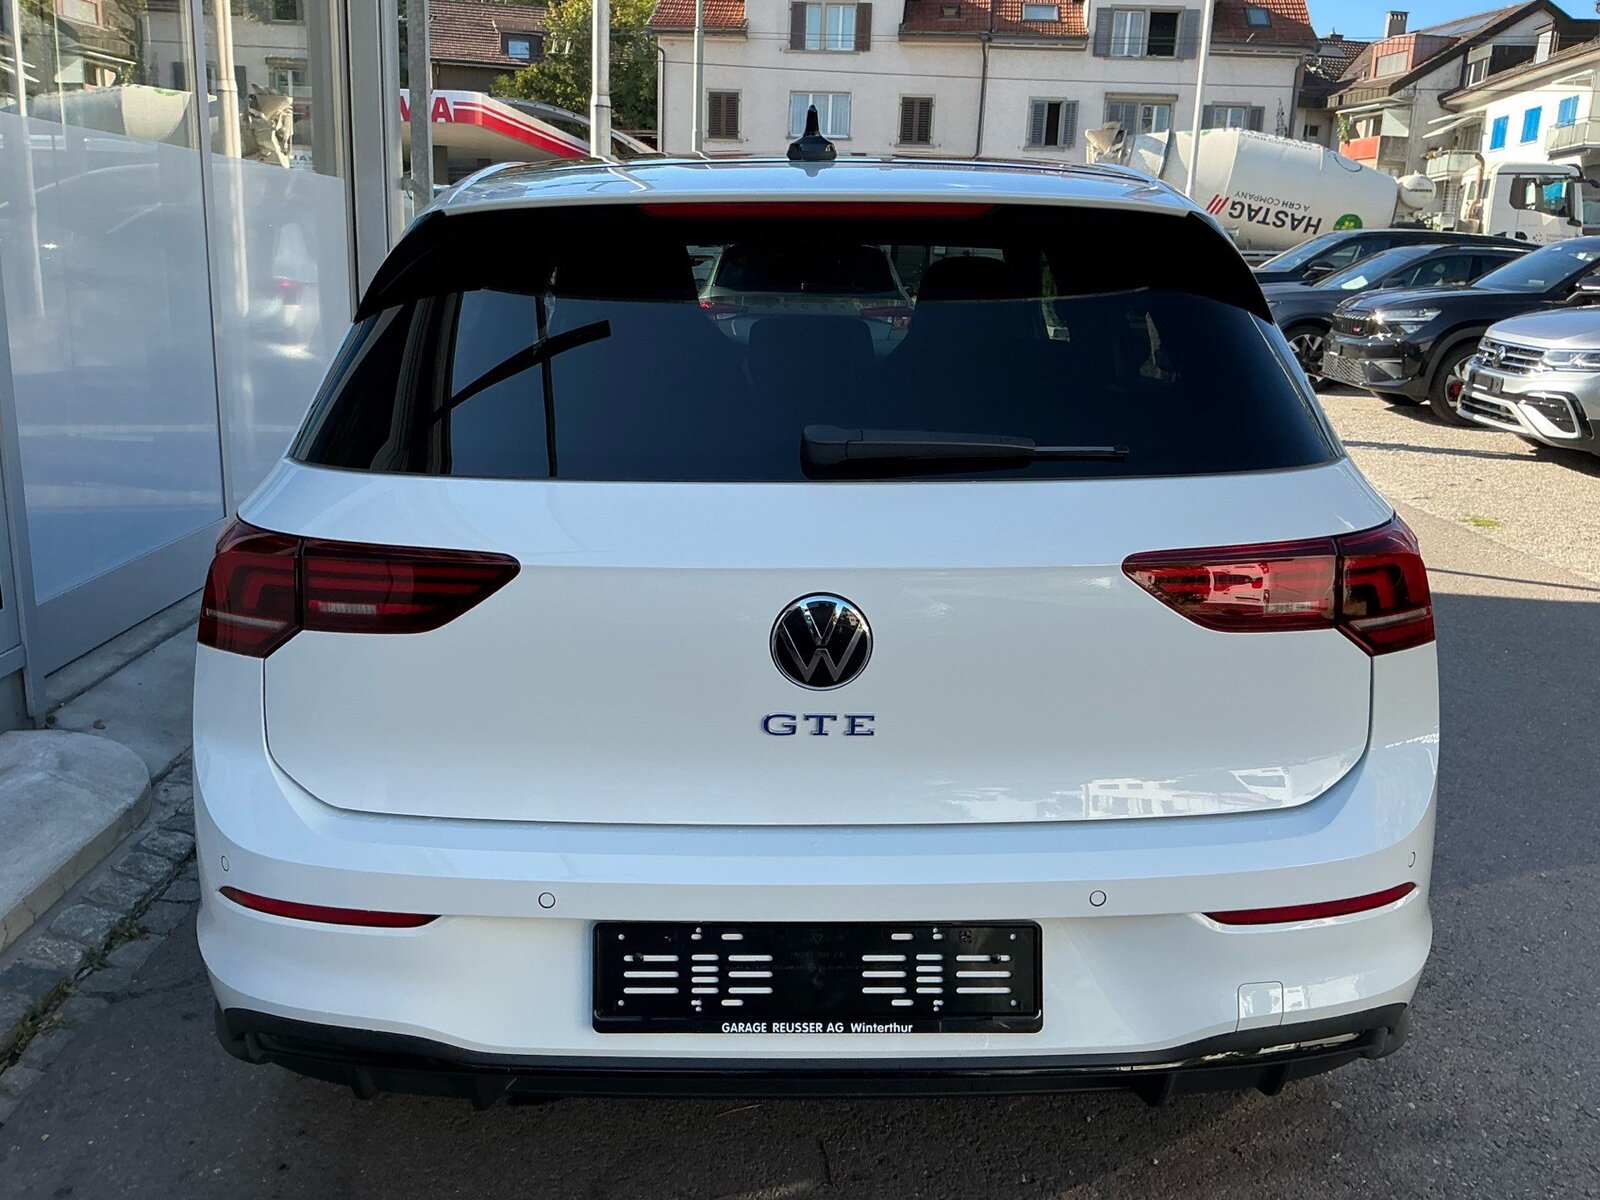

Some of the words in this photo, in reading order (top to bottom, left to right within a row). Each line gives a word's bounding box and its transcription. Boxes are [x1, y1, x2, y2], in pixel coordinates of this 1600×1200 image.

[1234, 191, 1281, 206] COMPANY
[1281, 200, 1302, 211] CRH
[1228, 200, 1322, 235] HASTAG
[761, 713, 876, 737] GTE
[721, 1022, 767, 1033] GARAGE
[772, 1022, 823, 1033] REUSSER
[826, 1022, 844, 1033] AG
[850, 1022, 914, 1033] Winterthur
